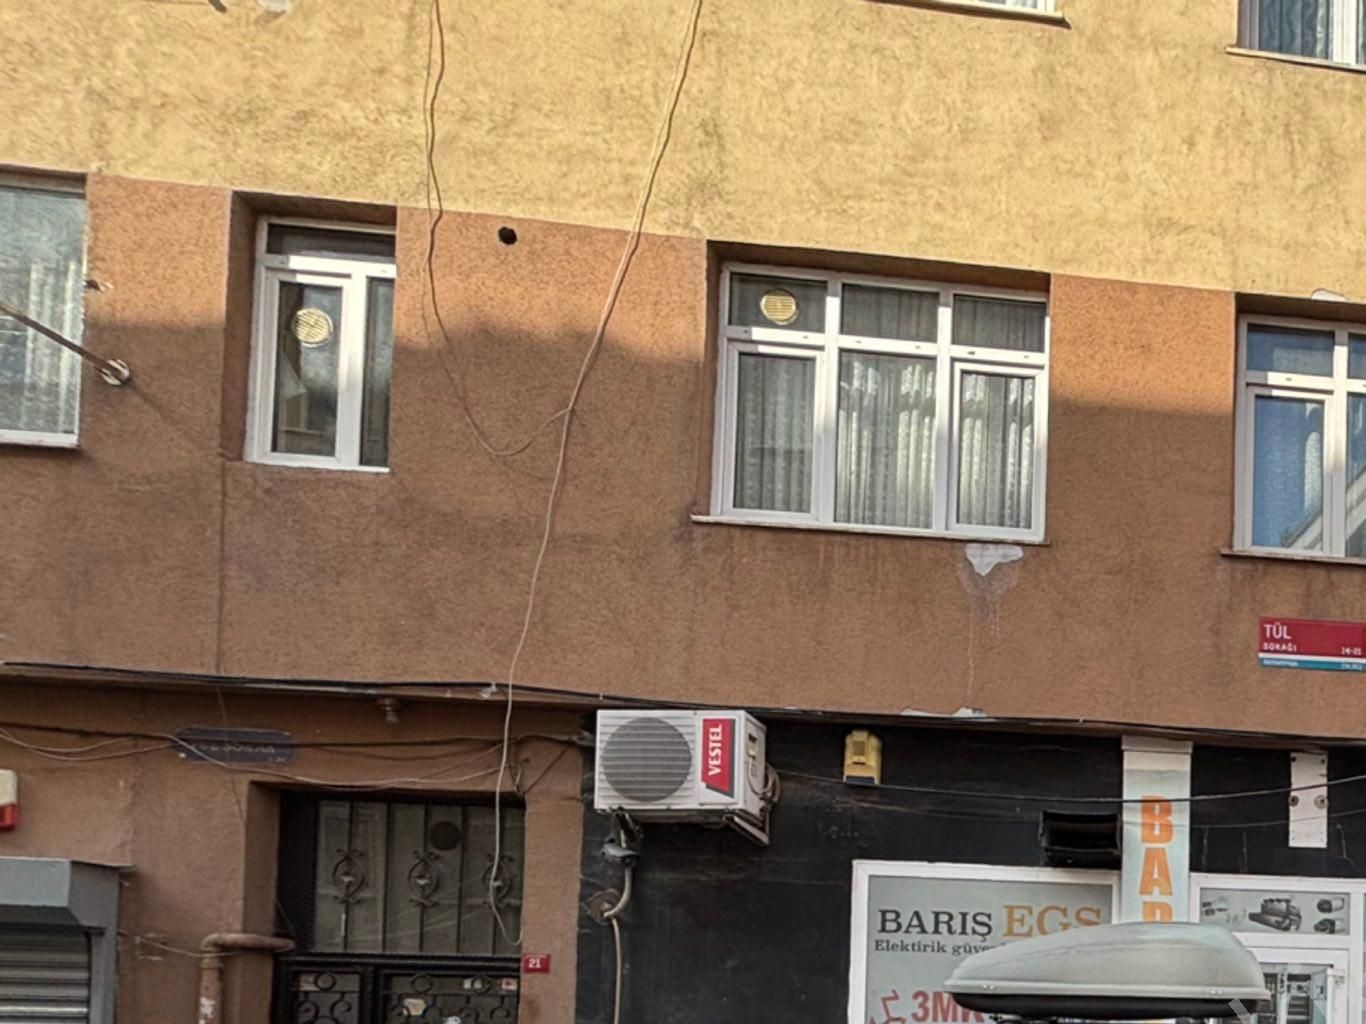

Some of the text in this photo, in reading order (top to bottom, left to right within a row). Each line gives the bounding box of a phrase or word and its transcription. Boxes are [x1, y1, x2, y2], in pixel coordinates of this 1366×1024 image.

[1264, 622, 1292, 640] TÜL
[707, 723, 723, 777] VESTEL
[877, 903, 1104, 943] BARIŞ EGS
[874, 938, 947, 954] Elektirik
[528, 957, 542, 969] 21
